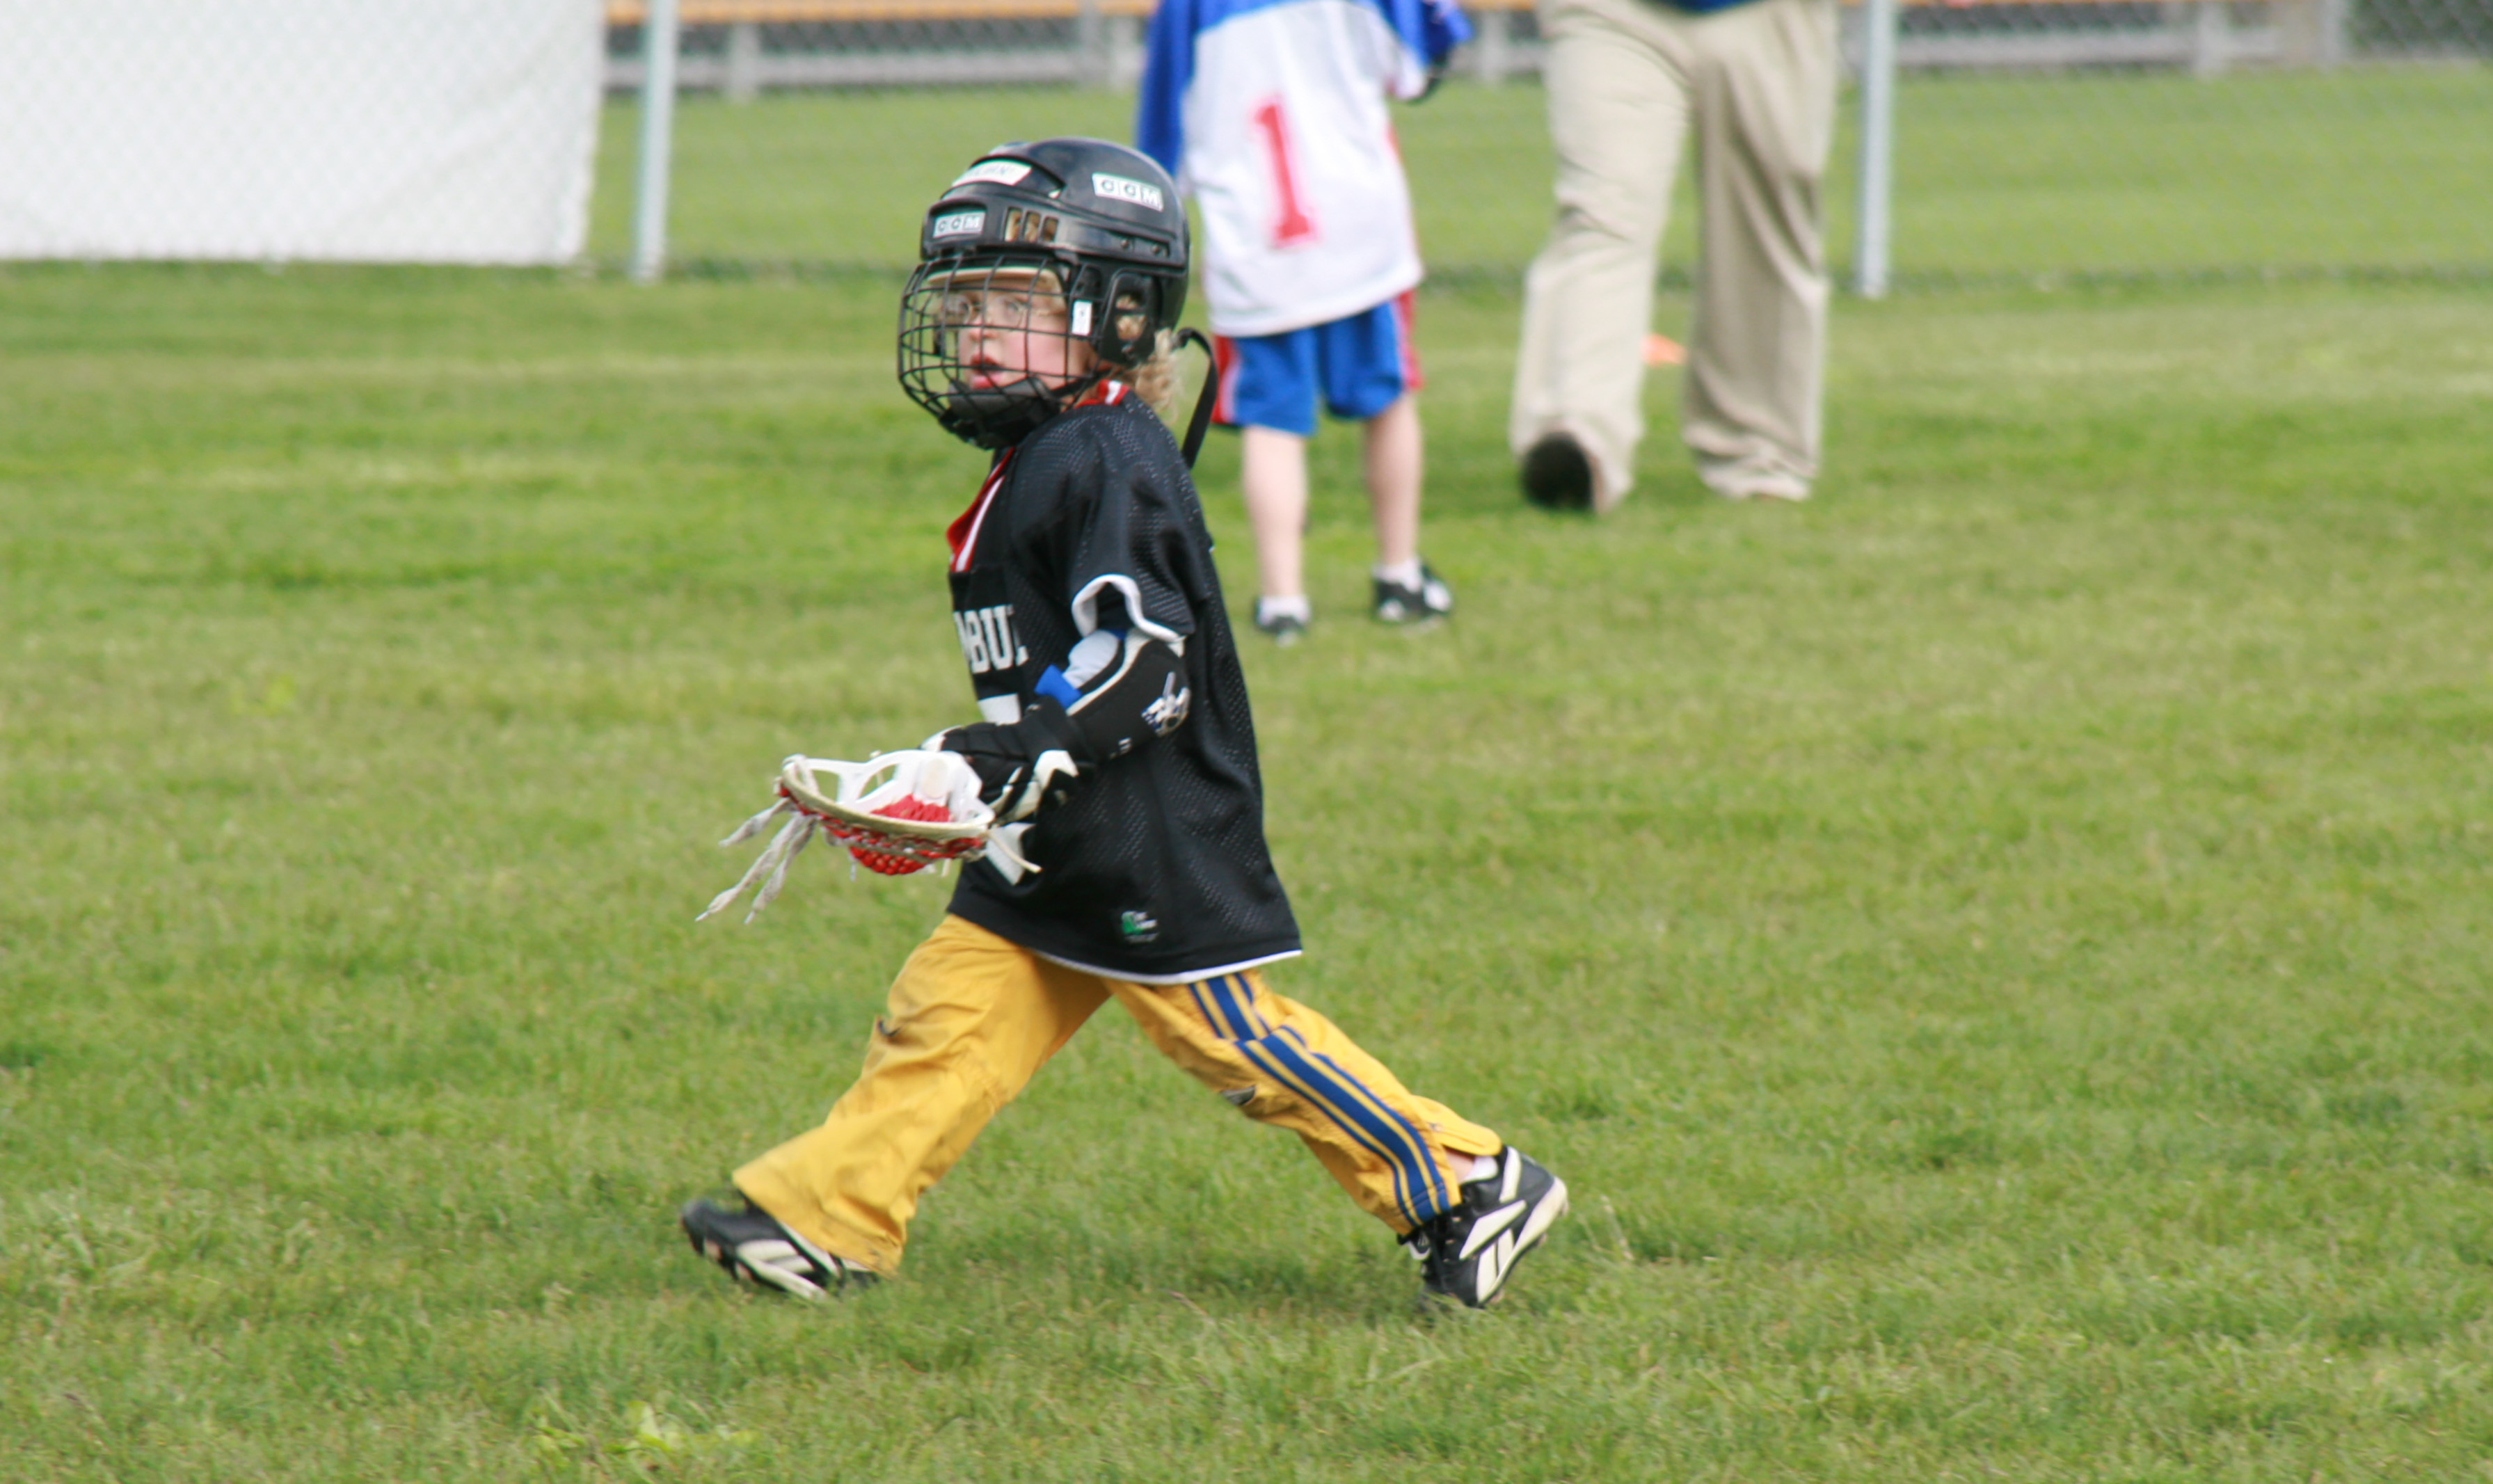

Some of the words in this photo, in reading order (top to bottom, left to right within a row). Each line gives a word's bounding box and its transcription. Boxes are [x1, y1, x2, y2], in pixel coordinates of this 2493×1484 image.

[1252, 101, 1314, 244] 1
[1099, 177, 1161, 210] CCM
[938, 214, 982, 233] CCM
